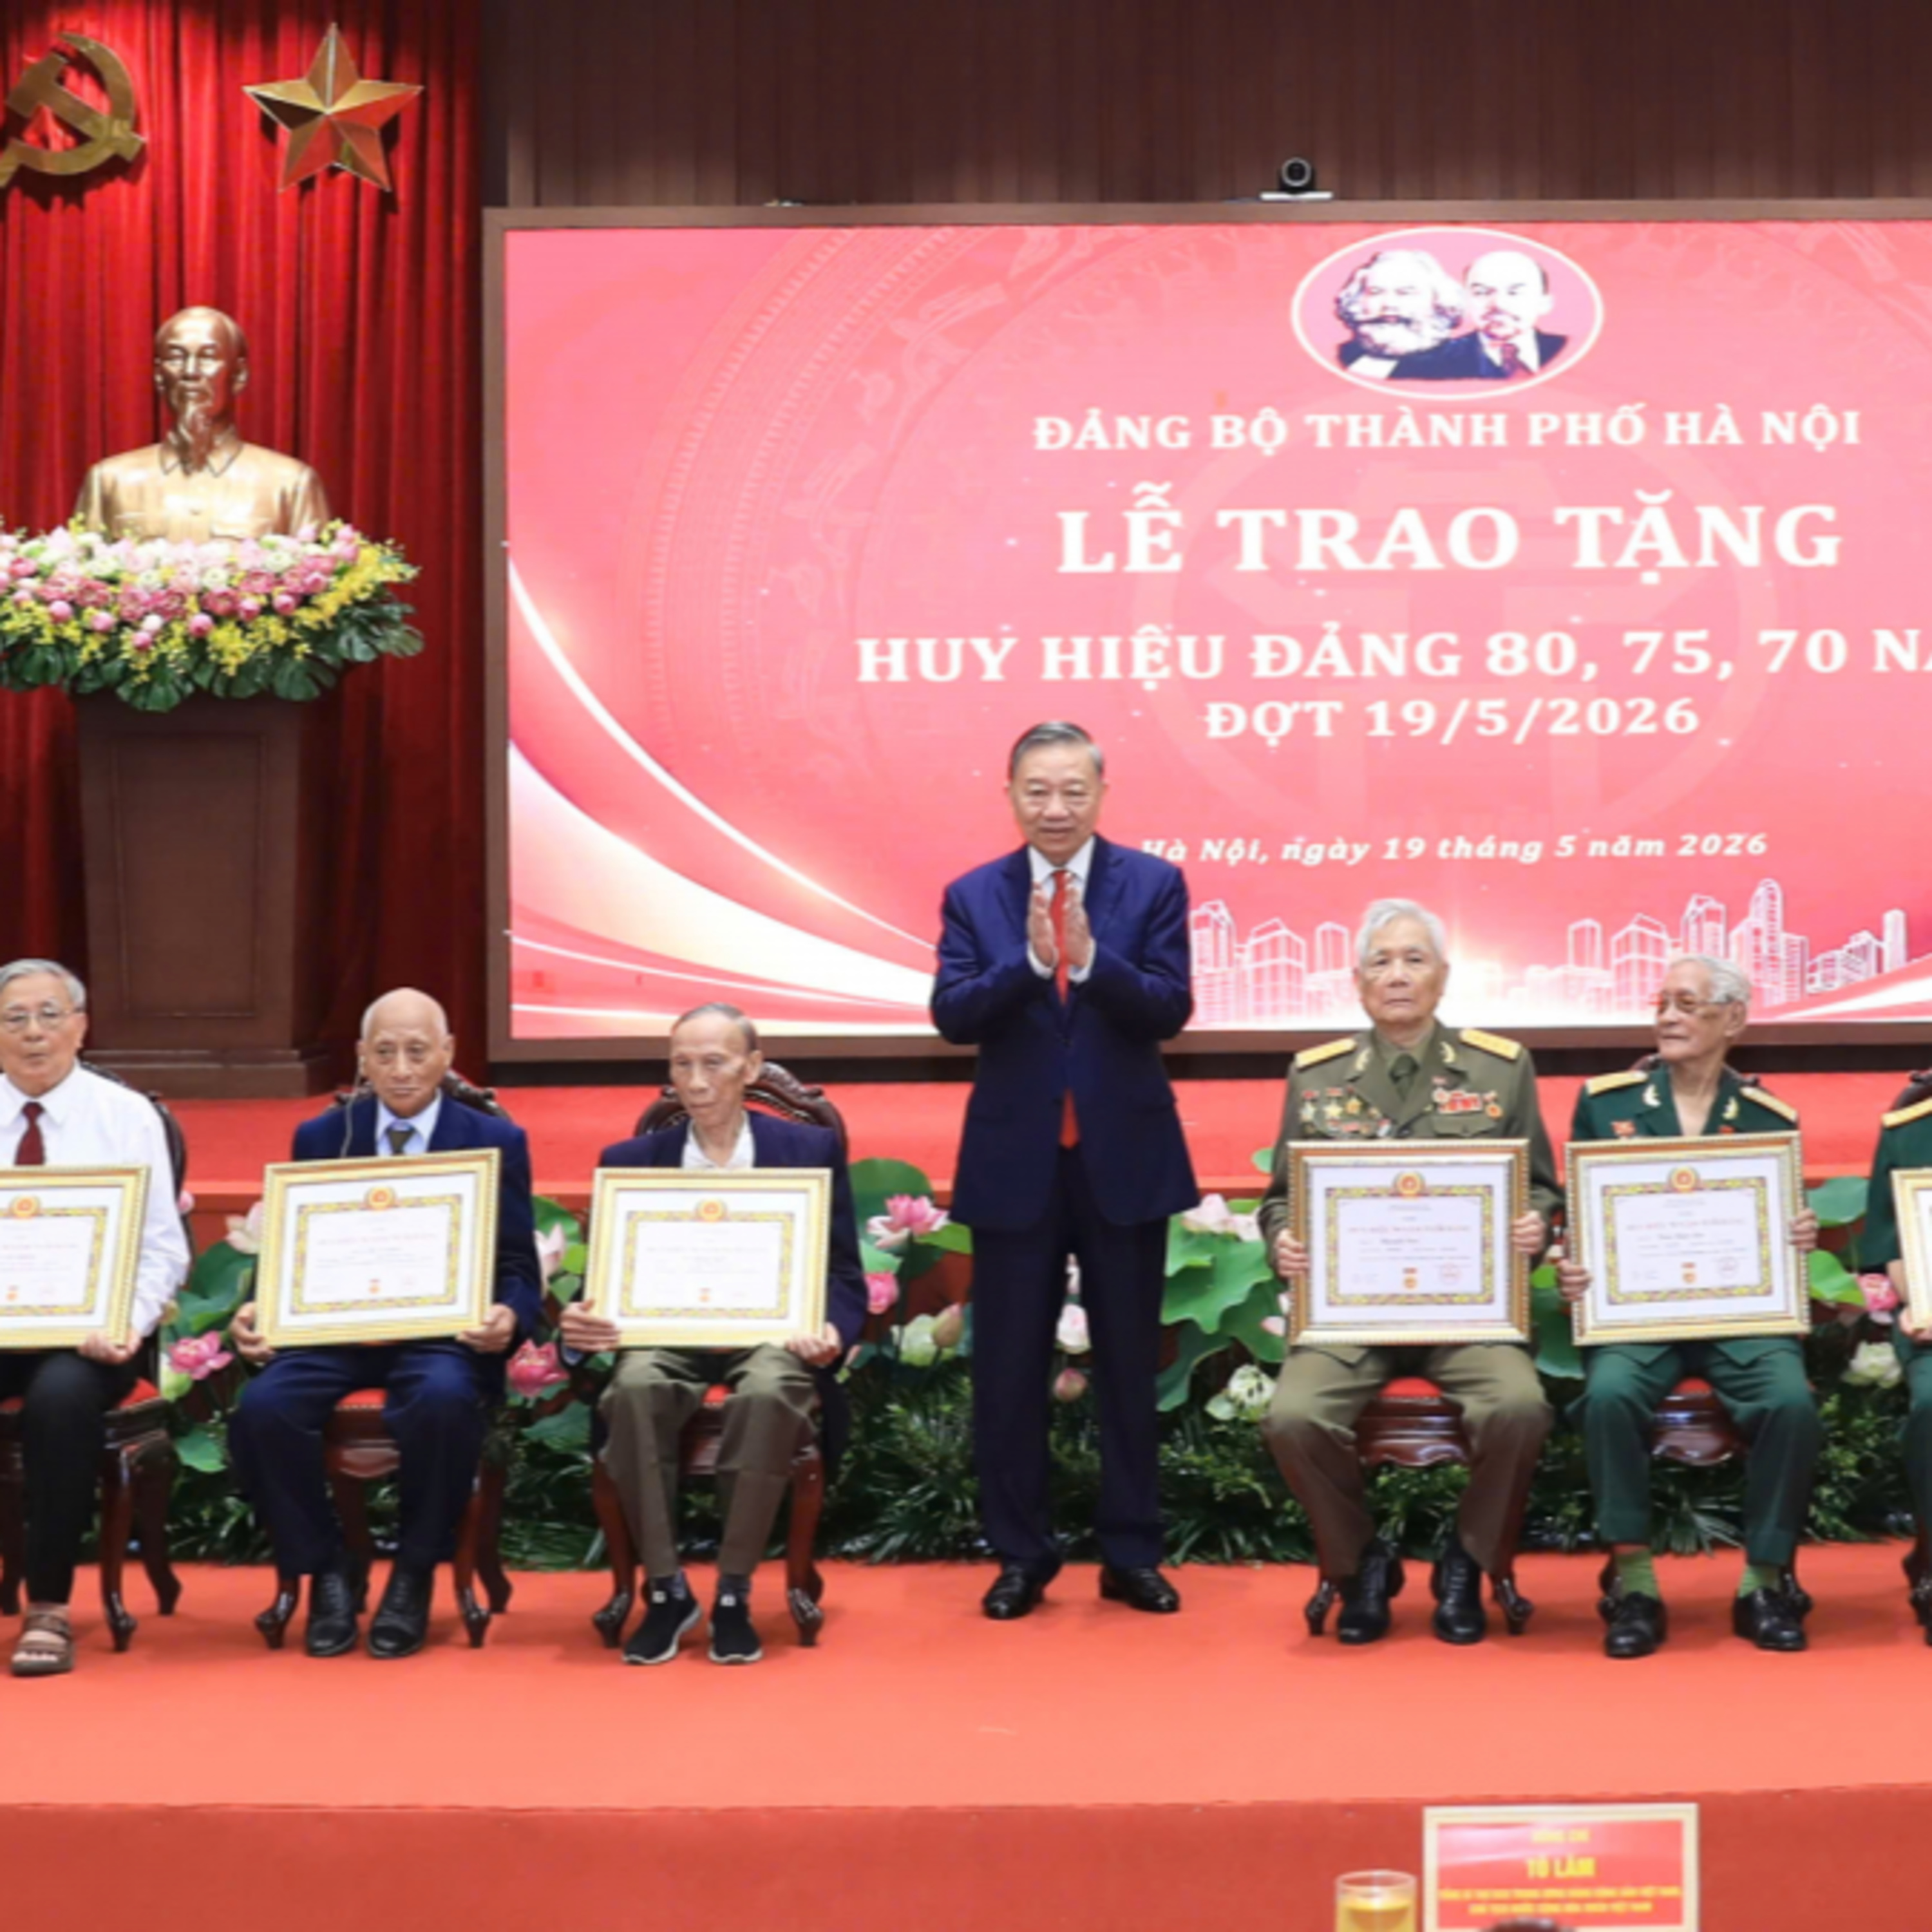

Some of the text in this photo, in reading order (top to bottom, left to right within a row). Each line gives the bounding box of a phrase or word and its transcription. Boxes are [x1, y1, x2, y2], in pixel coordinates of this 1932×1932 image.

[1032, 402, 1860, 457] ĐẢNG BỘ THÀNH PHỐ HÀ NỘI
[1057, 480, 1842, 586] LẼ TRAO TẶNG
[856, 620, 1932, 690] HUY HIỆU ĐẢNG 80, 75, 70 N
[1203, 699, 1699, 747] ĐỢT 19/5/2026
[1200, 838, 1268, 866] Nội,
[1281, 837, 1371, 866] ngày
[1383, 837, 1426, 860] 19
[1437, 835, 1543, 864] tháng
[1555, 835, 1577, 857] 5
[1587, 835, 1665, 857] năm
[1677, 833, 1766, 856] 2026
